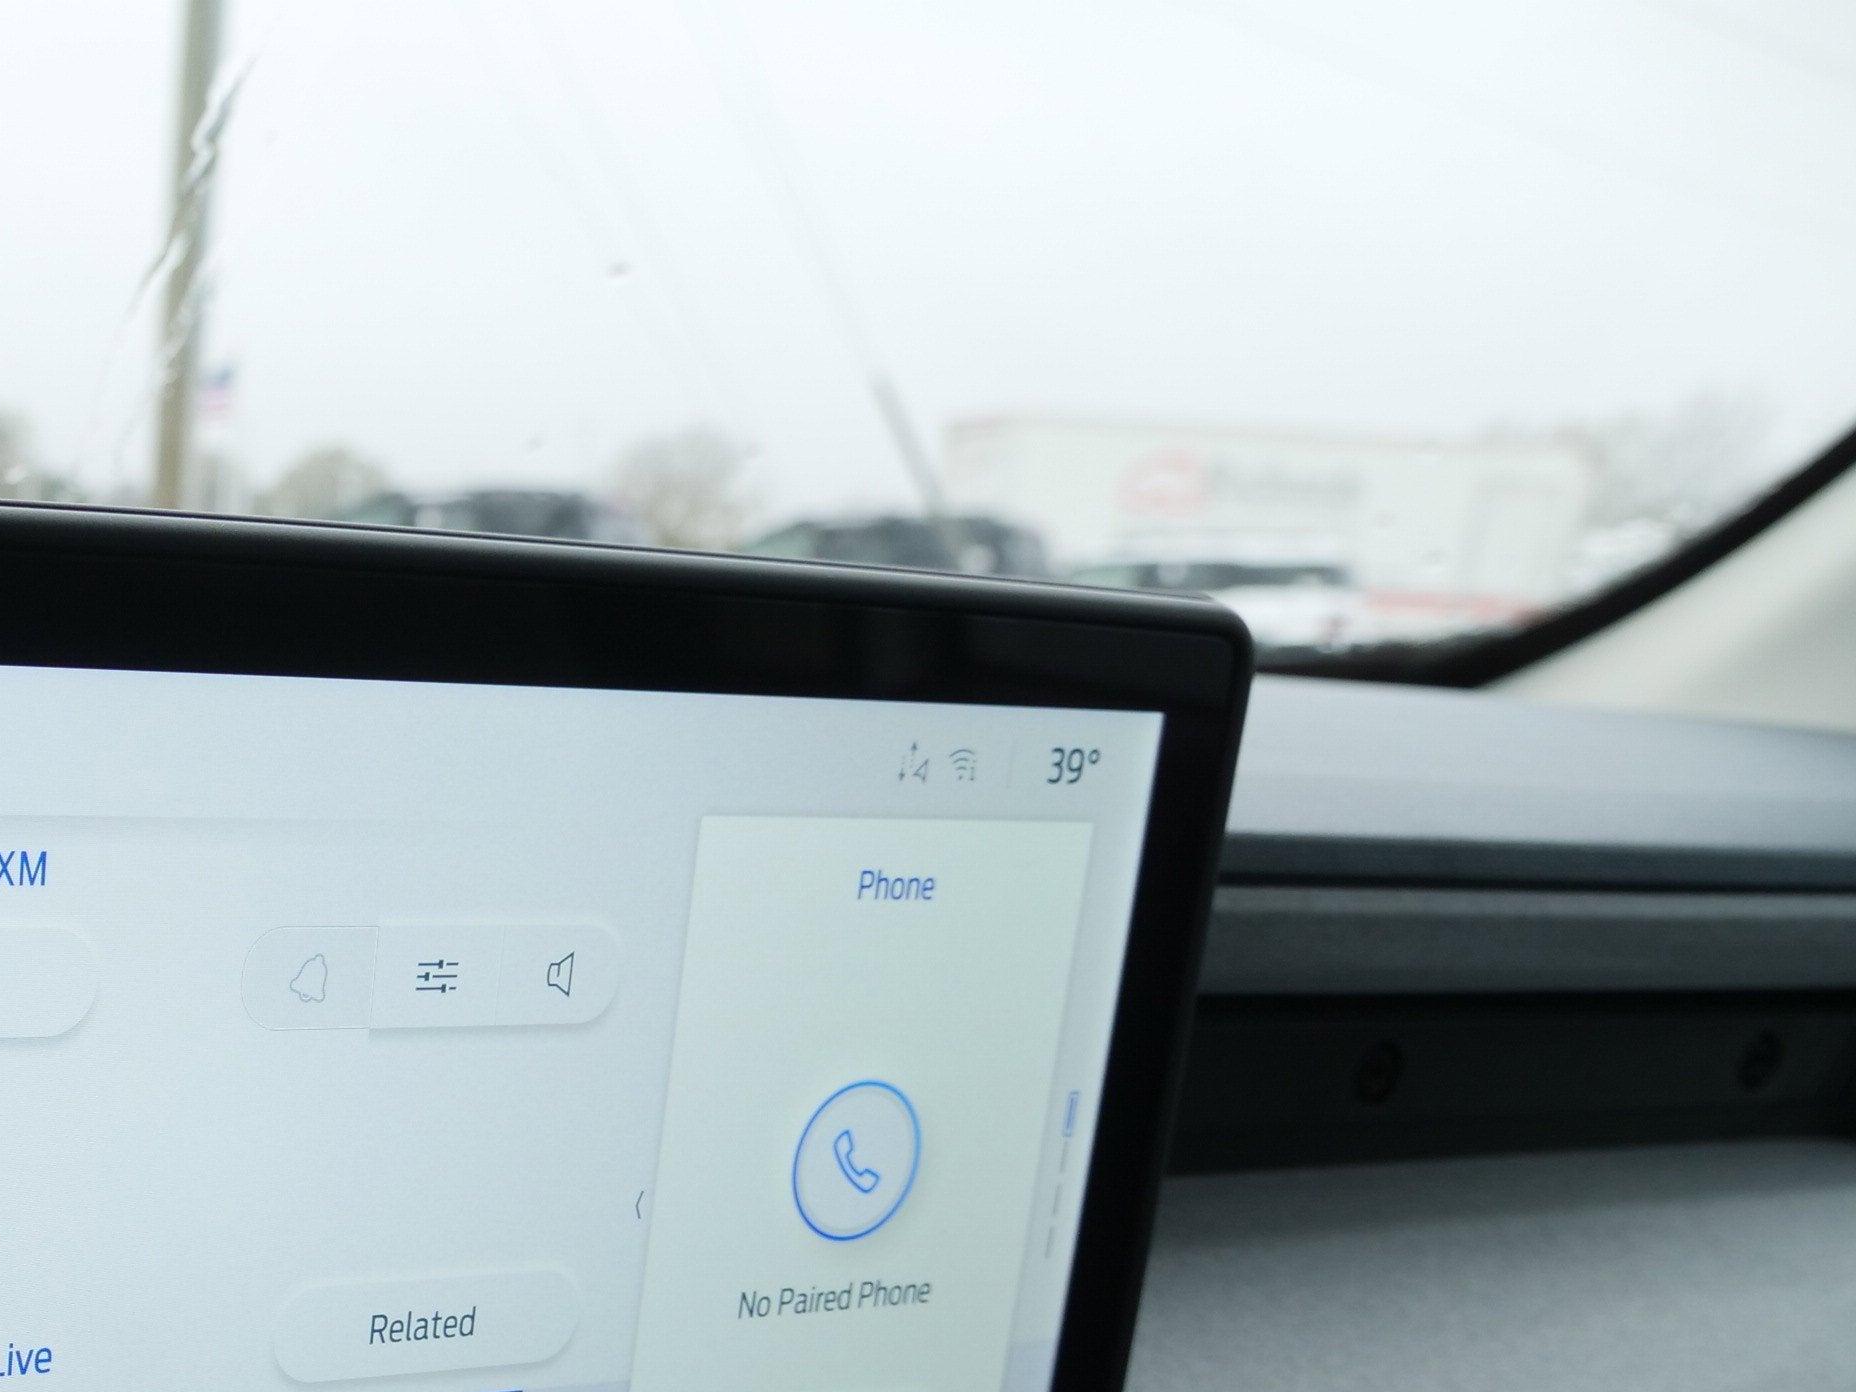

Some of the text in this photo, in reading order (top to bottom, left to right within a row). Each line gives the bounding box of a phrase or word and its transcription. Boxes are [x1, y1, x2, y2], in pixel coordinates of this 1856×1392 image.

[857, 870, 936, 900] Phone
[737, 1278, 932, 1320] No Paired Phone
[369, 1306, 477, 1346] Related
